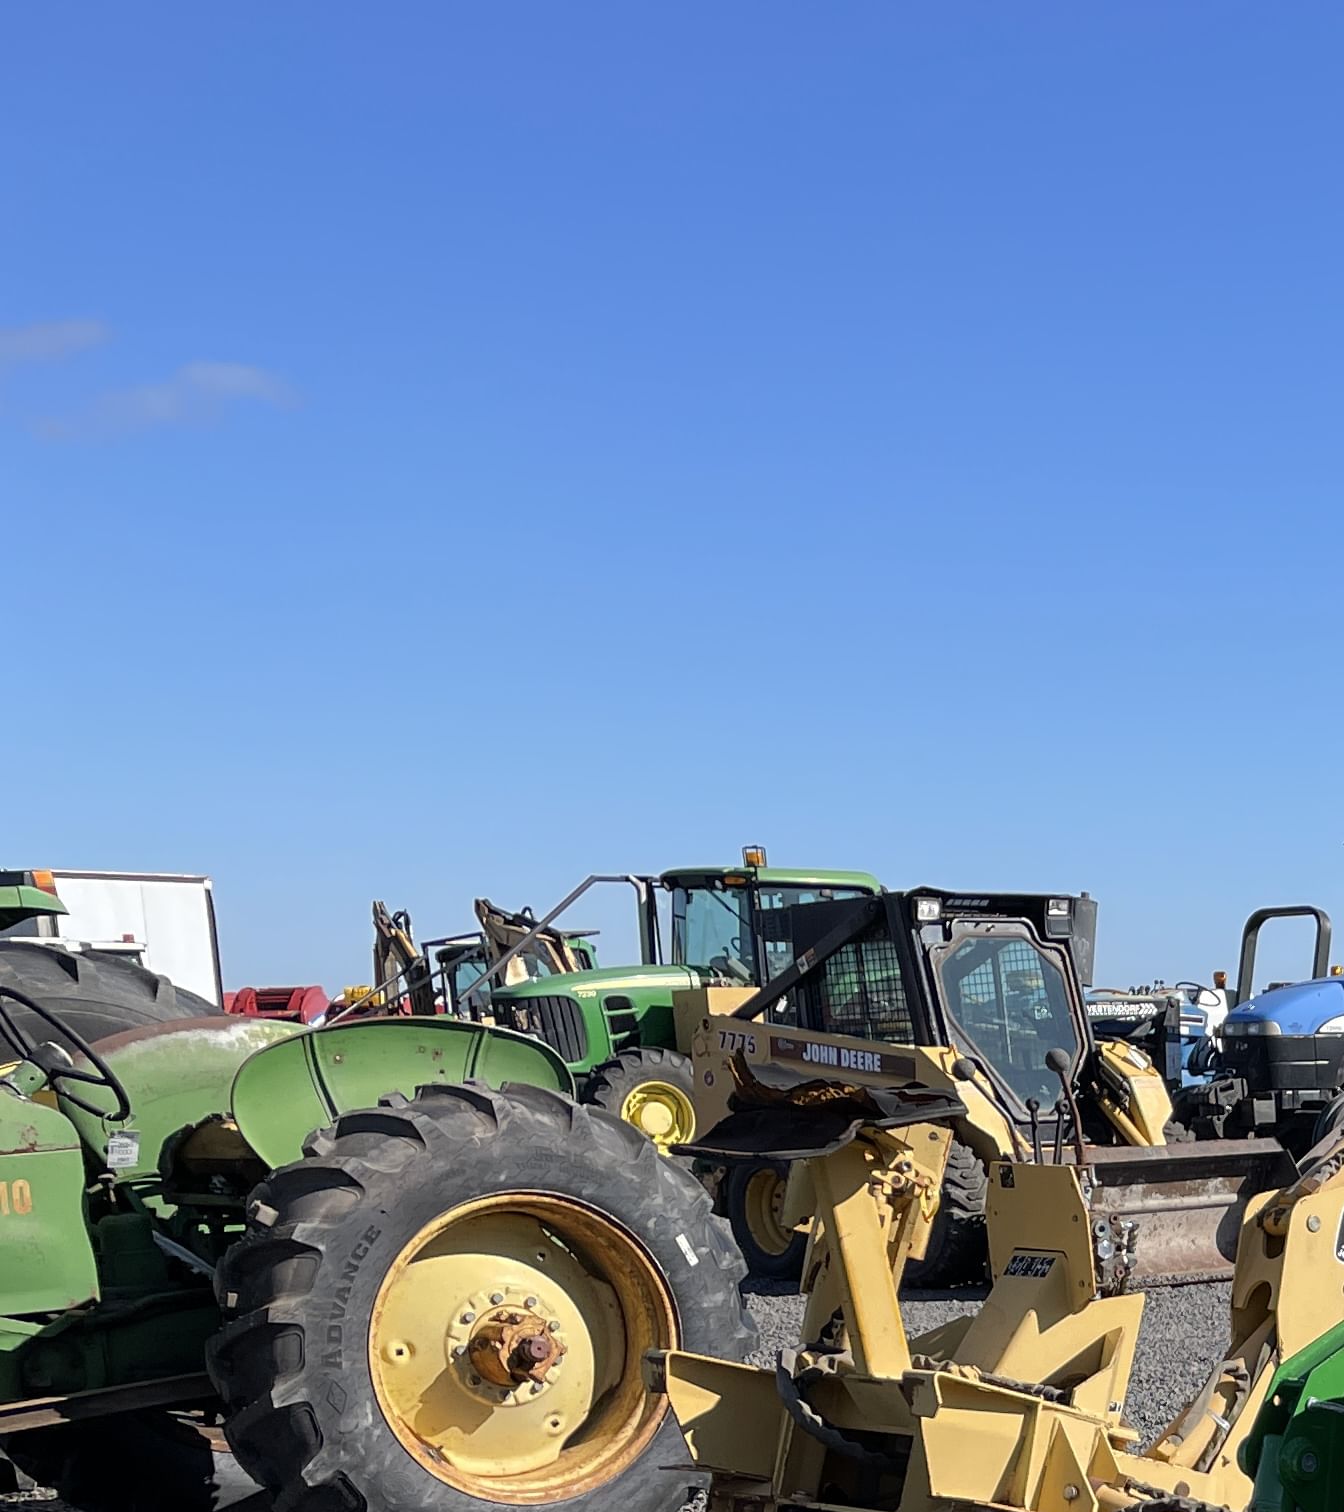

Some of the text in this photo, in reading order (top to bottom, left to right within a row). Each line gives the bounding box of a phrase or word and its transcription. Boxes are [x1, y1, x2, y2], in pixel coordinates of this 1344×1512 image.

[802, 1043, 882, 1073] JOHN DEERE
[320, 1225, 382, 1370] ADVANCE
